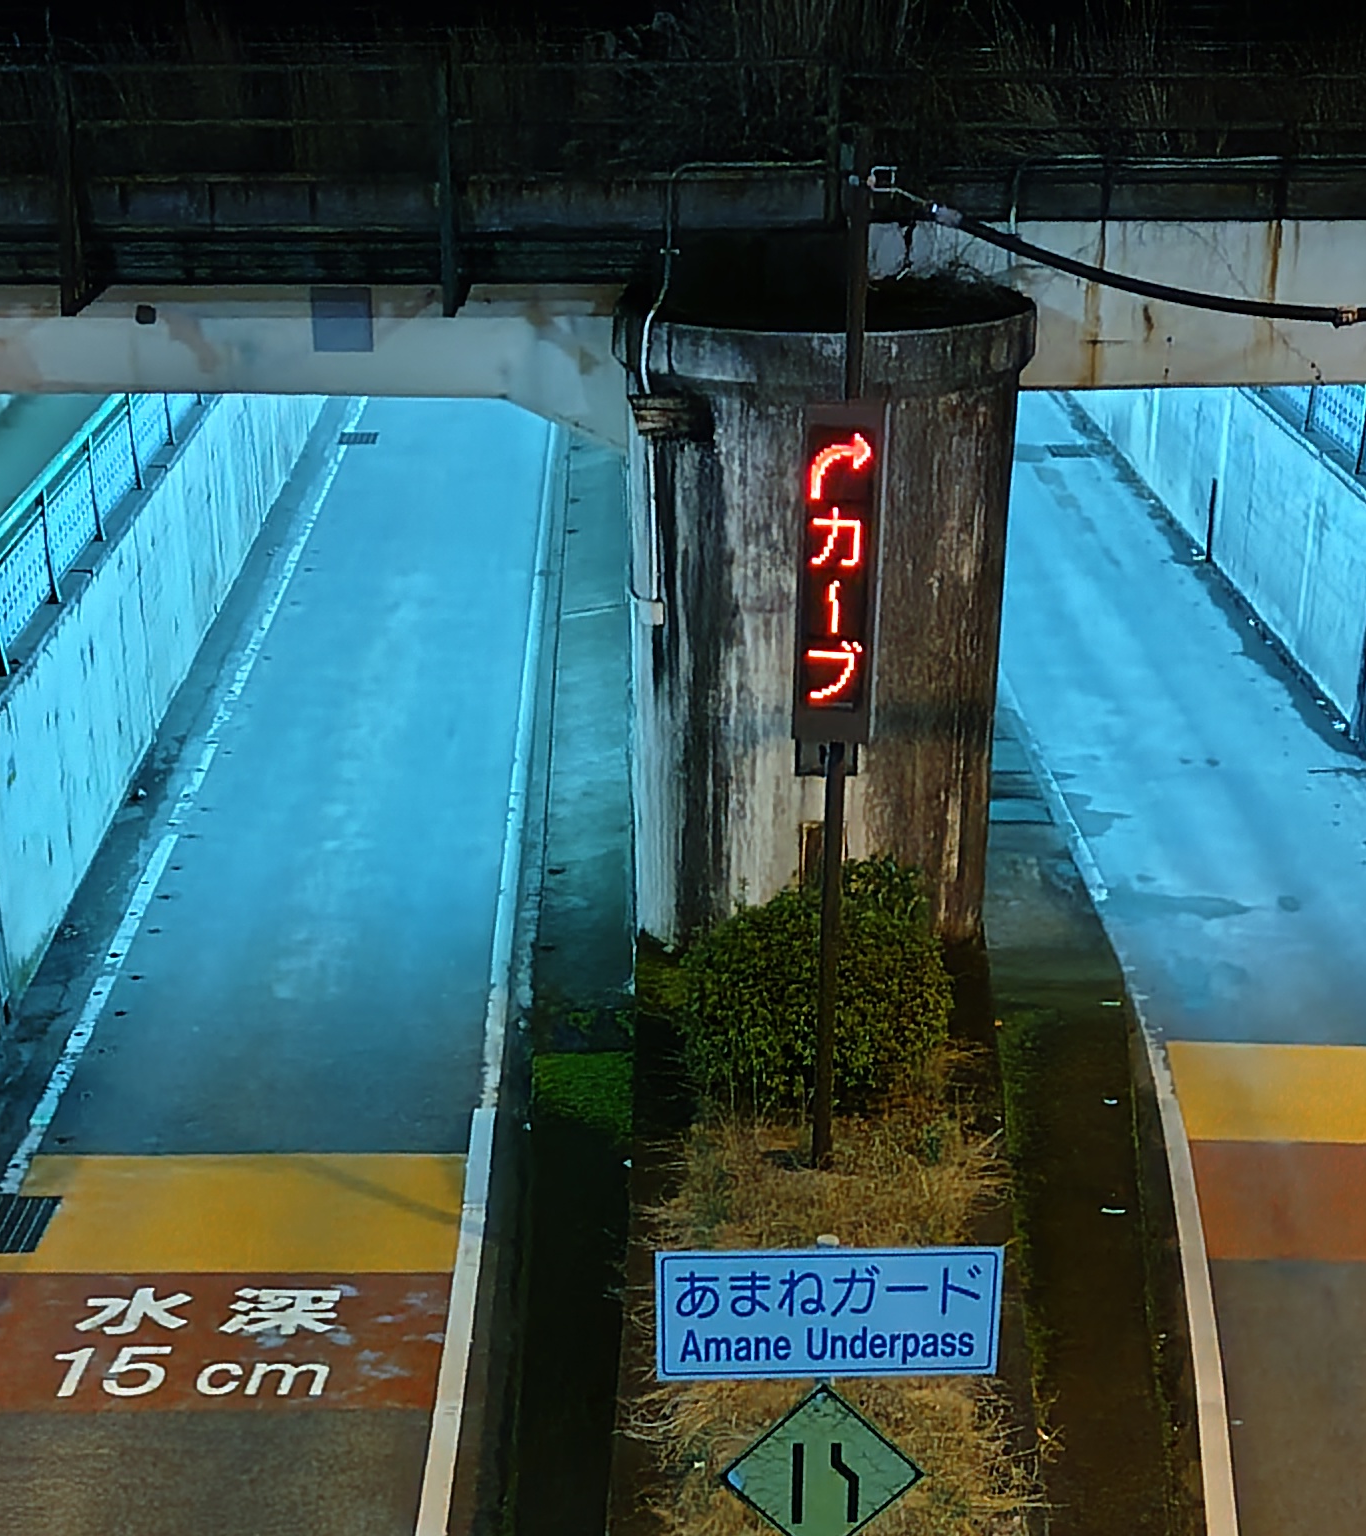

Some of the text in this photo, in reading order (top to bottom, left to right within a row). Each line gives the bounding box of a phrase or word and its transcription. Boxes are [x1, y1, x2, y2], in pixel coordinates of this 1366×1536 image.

[807, 506, 863, 699] カーブ
[75, 1286, 342, 1336] 水深
[675, 1264, 983, 1319] あまねガード
[679, 1326, 976, 1364] Amane Underpass
